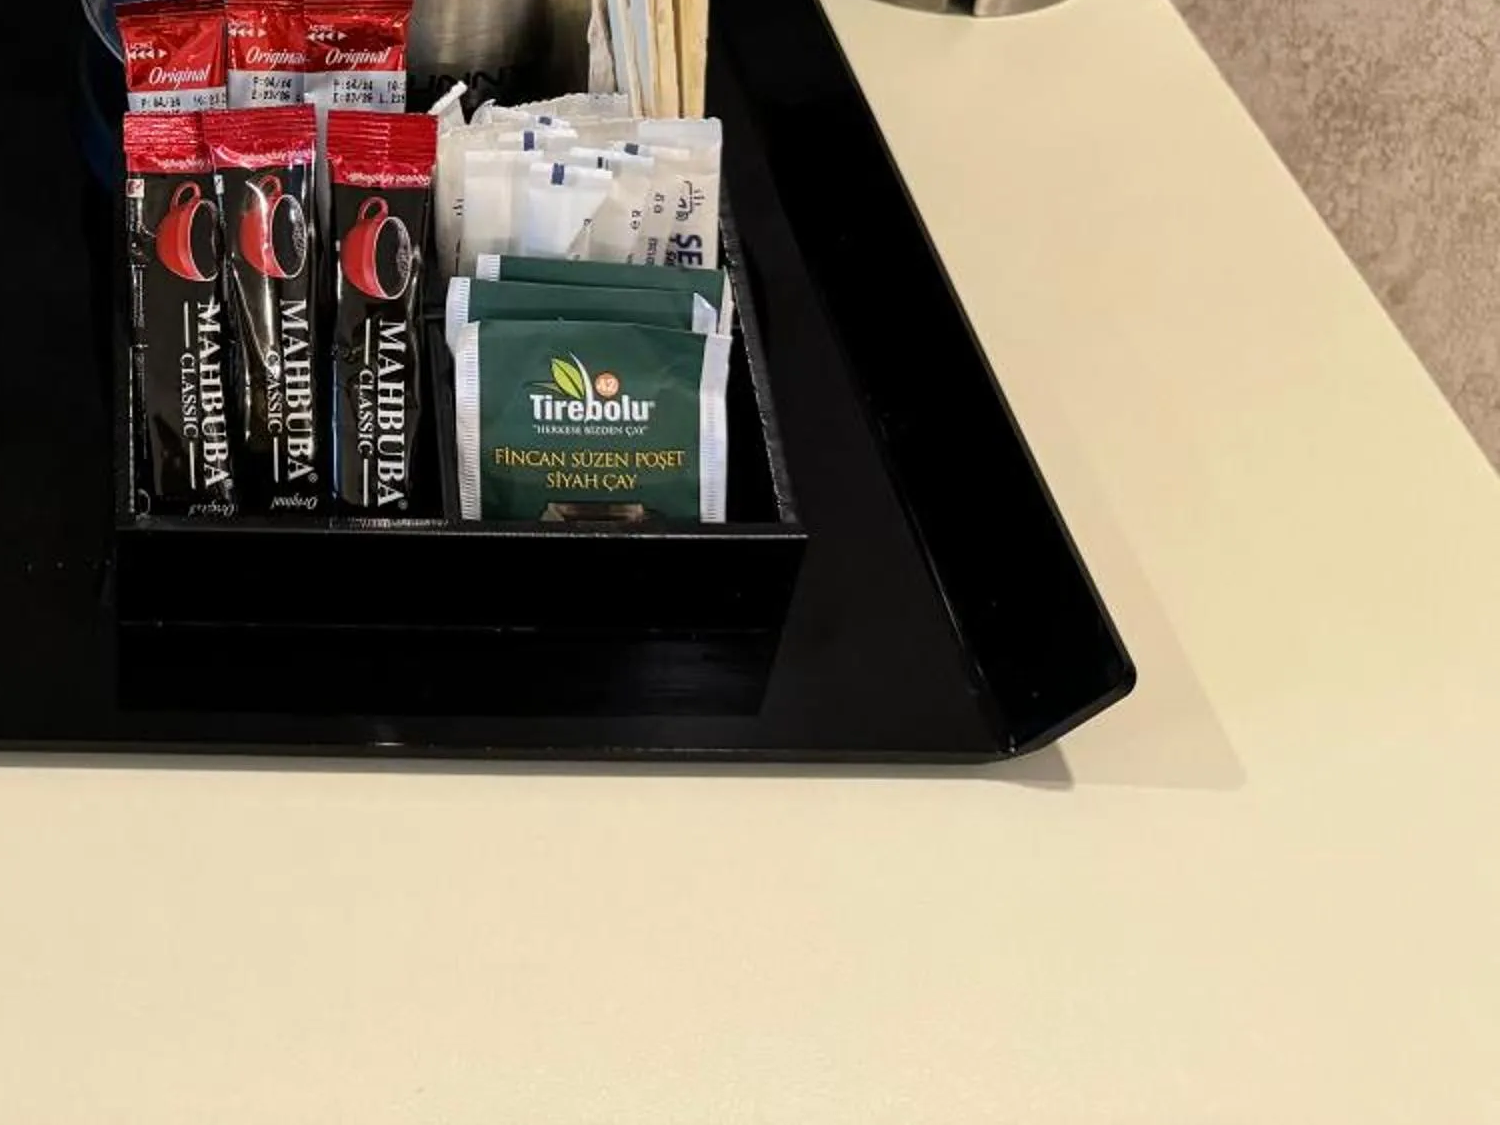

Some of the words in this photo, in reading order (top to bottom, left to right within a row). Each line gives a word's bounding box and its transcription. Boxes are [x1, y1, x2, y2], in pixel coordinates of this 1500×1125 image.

[245, 47, 306, 70] Origina
[325, 46, 391, 70] Original
[148, 63, 211, 90] Original
[179, 353, 199, 438] CLASSIC
[197, 301, 231, 487] MAHBUBA
[280, 299, 315, 481] MAHBUBA
[357, 369, 375, 456] CLASSIC
[377, 320, 407, 507] MAHBUBA
[530, 395, 649, 423] Tirebolu
[495, 447, 565, 466] FİNCAN
[571, 448, 629, 468] SÜZEN
[635, 451, 686, 470] POŞET
[547, 472, 599, 489] SİYAH
[603, 474, 637, 491] ÇAY
[270, 494, 318, 510] Original
